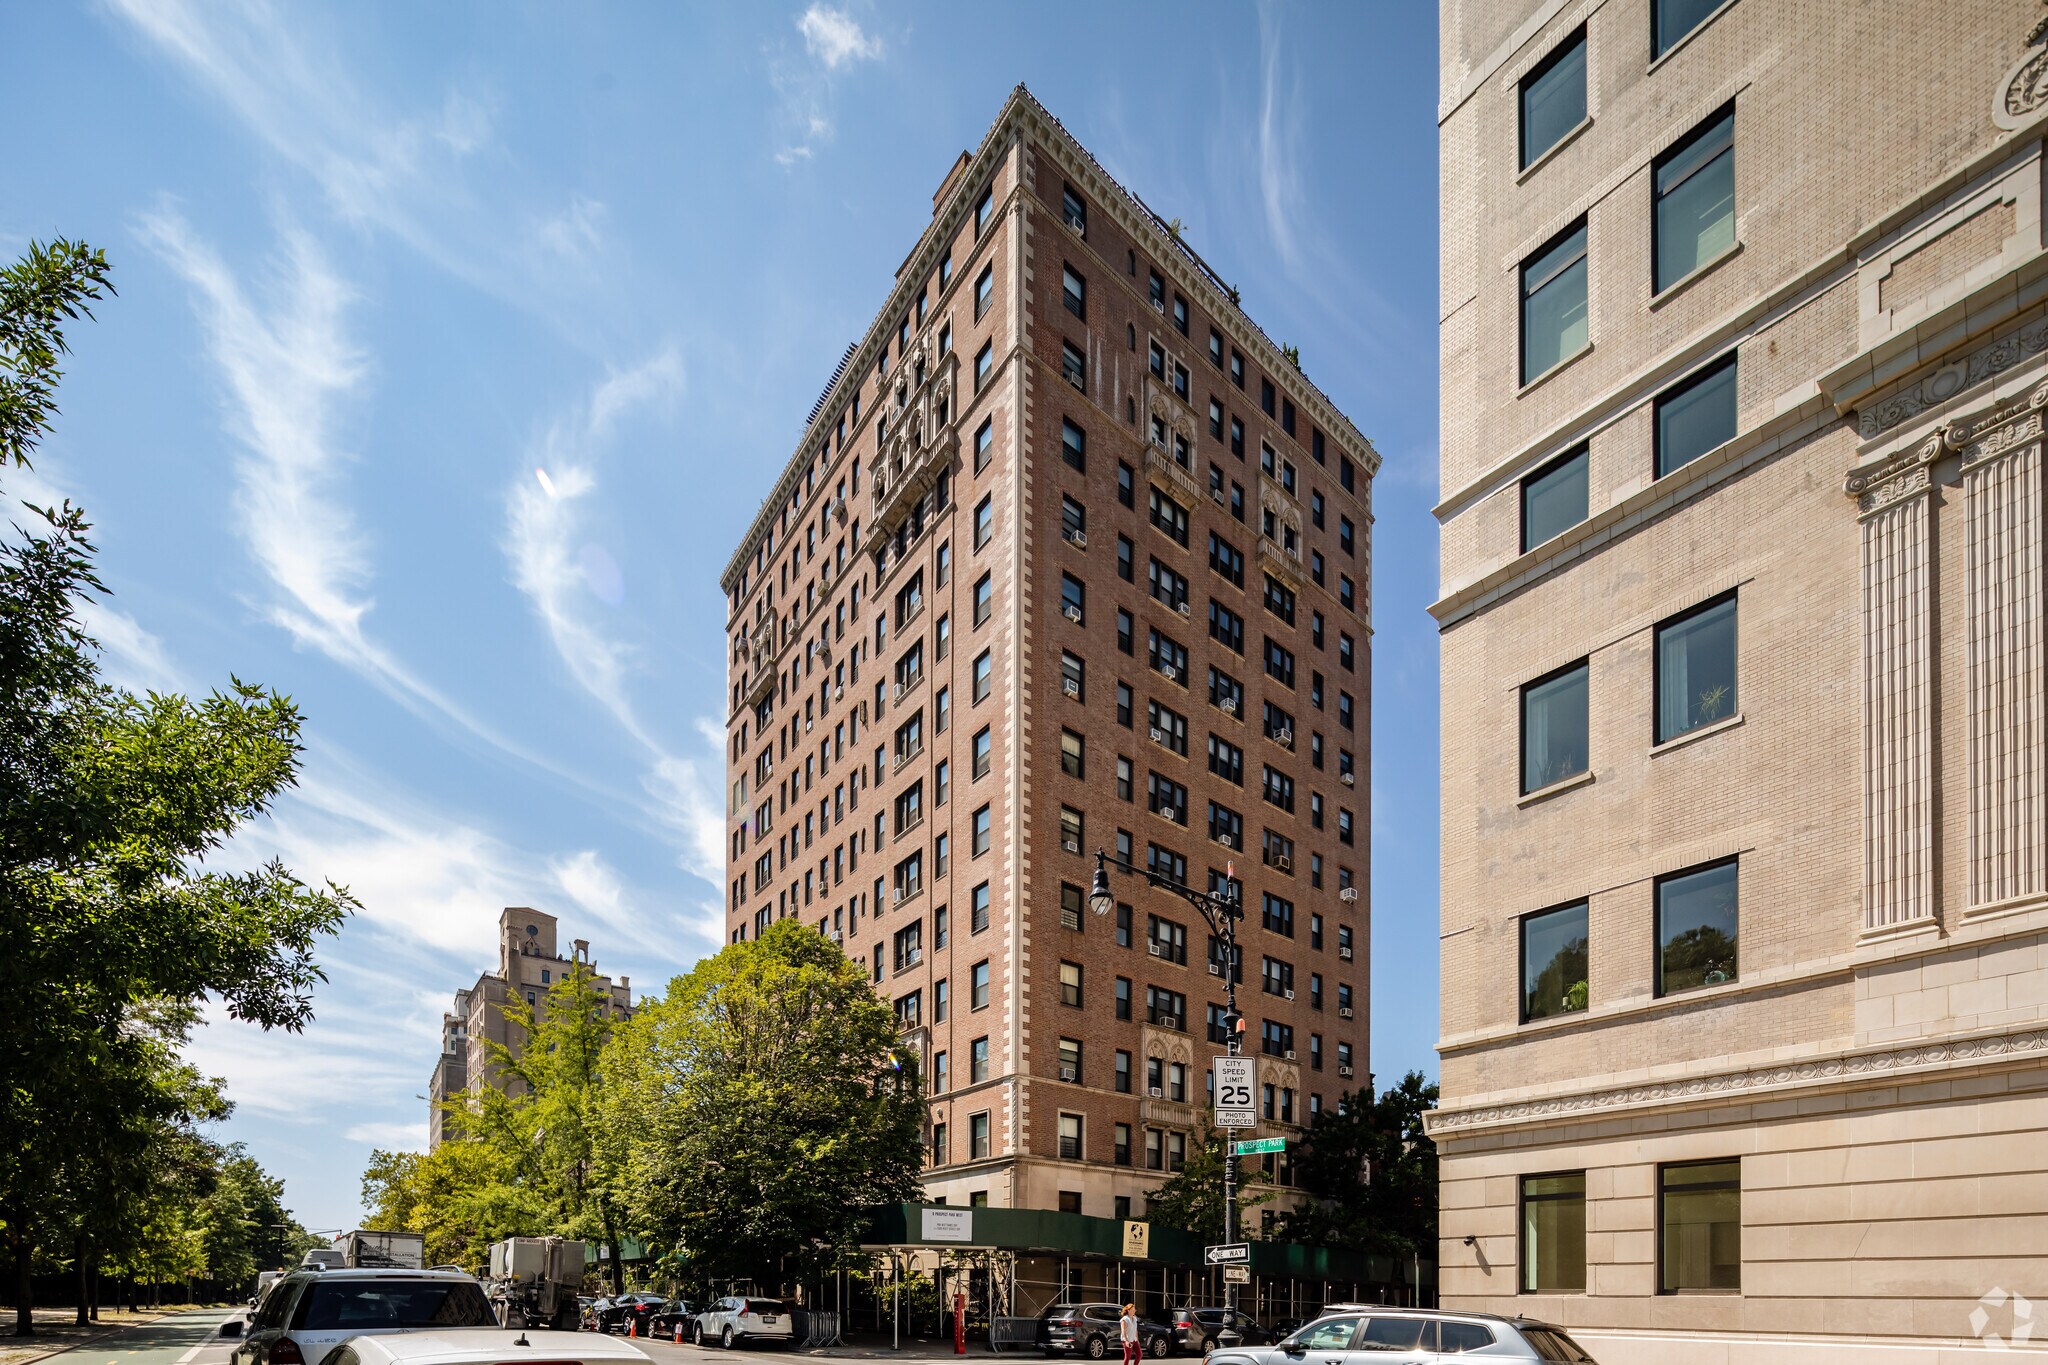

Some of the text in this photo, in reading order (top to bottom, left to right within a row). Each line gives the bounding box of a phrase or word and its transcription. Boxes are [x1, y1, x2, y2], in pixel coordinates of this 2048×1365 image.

[1222, 1068, 1246, 1076] SPEED
[1221, 1085, 1251, 1105] 25
[1237, 1138, 1283, 1150] PROSPECT PARK
